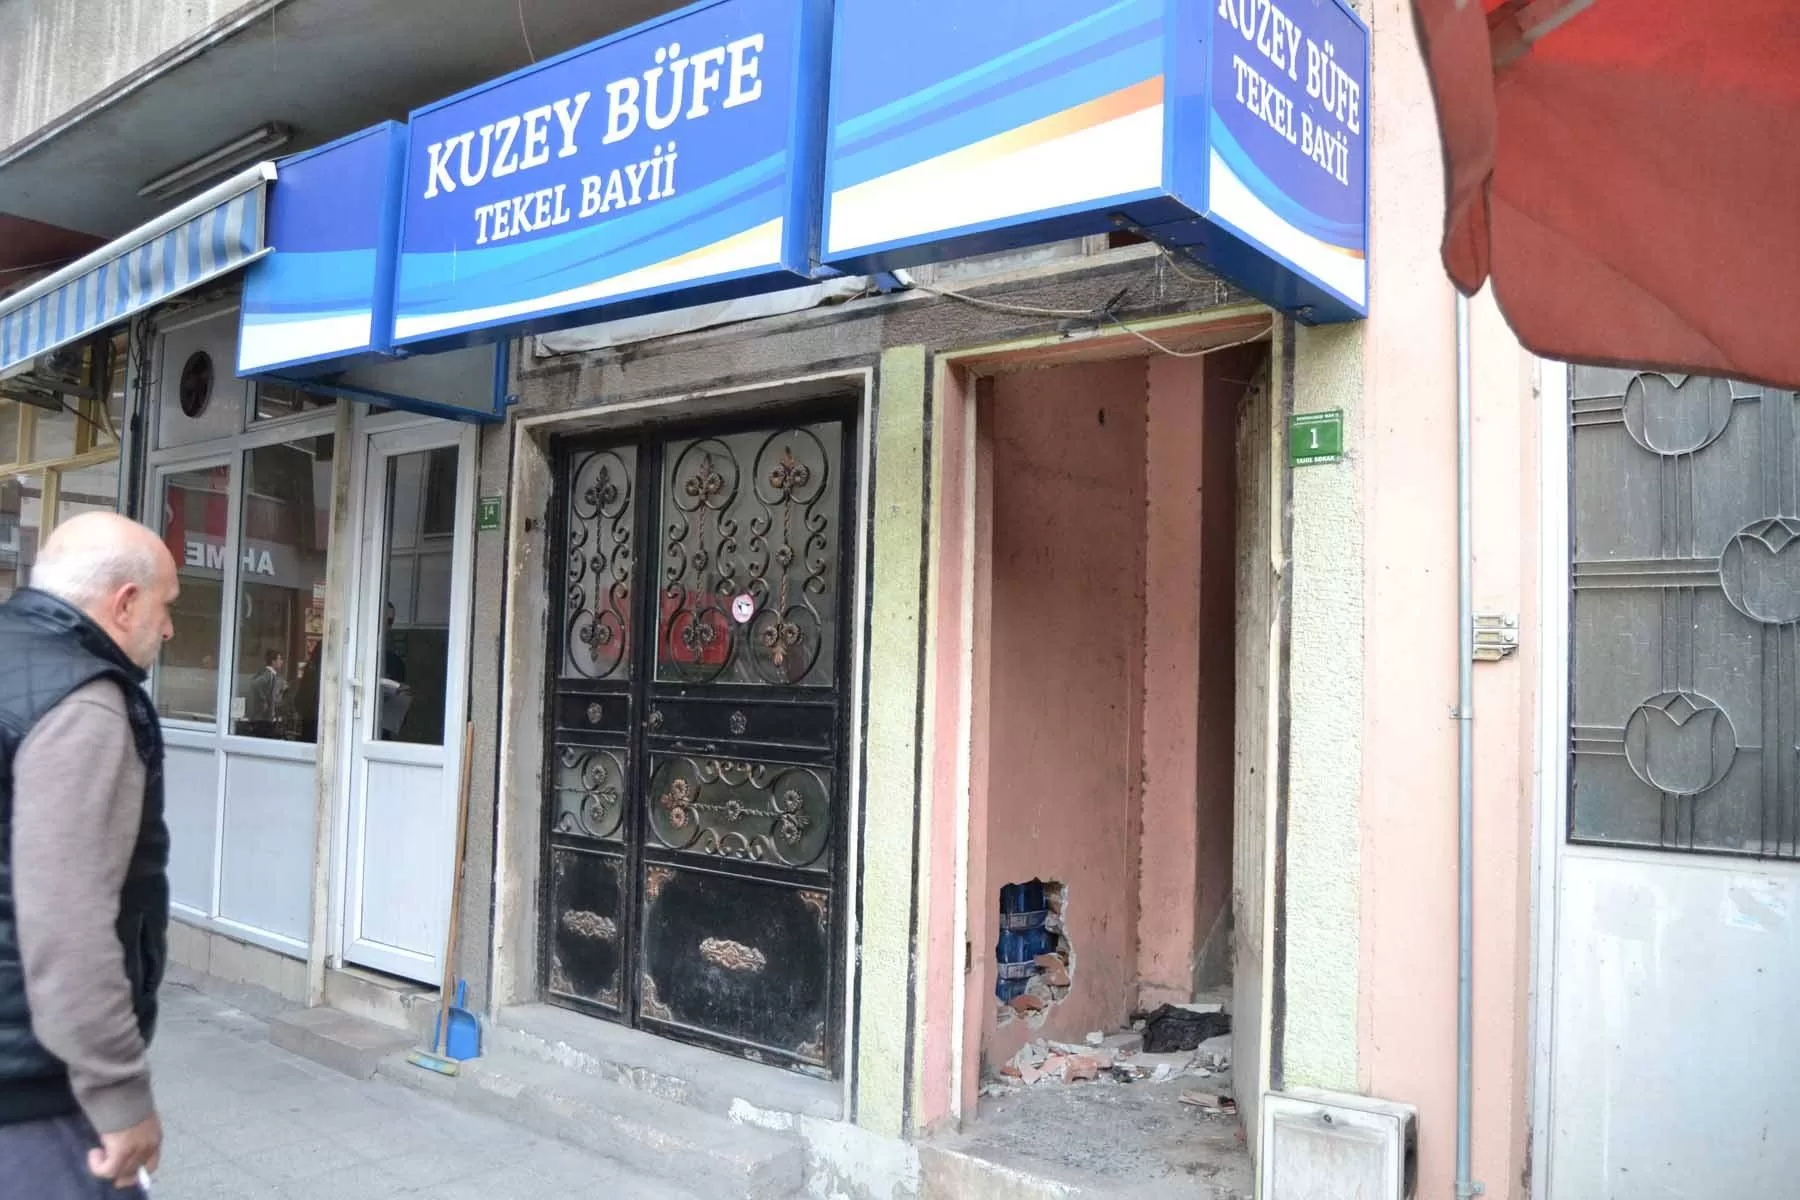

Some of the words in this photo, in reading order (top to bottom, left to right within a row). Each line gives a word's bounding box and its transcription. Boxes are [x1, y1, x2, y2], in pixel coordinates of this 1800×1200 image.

[423, 91, 591, 200] KUZEY
[602, 32, 765, 145] BÜFE
[1232, 54, 1297, 145] TEKEL
[1305, 37, 1360, 135] BÜFE
[474, 184, 570, 246] TEKEL
[579, 140, 678, 219] BAYİİ
[1310, 428, 1319, 449] 1
